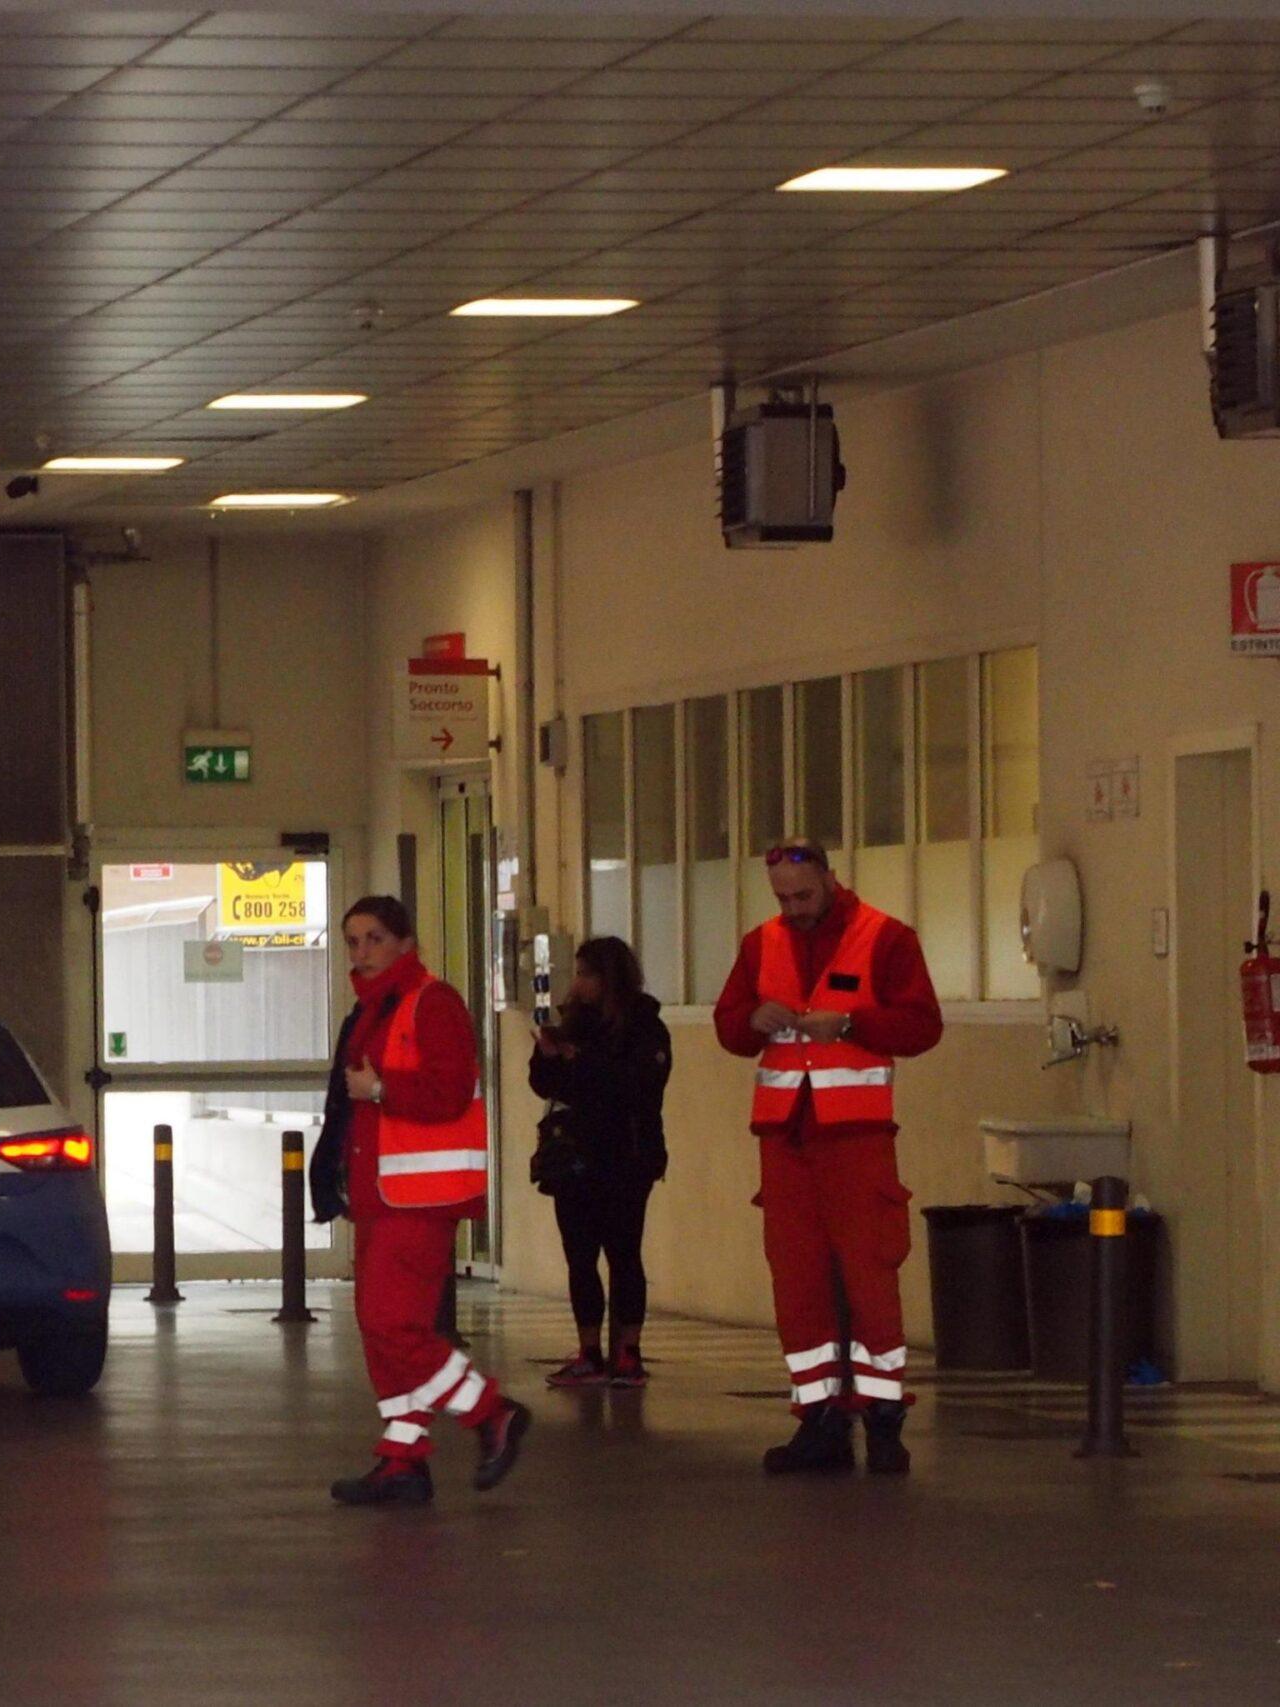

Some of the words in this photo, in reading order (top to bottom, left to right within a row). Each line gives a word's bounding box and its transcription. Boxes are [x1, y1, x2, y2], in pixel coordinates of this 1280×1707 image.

[409, 681, 459, 694] Pronto
[409, 699, 473, 712] Soccorso
[244, 901, 272, 918] 800
